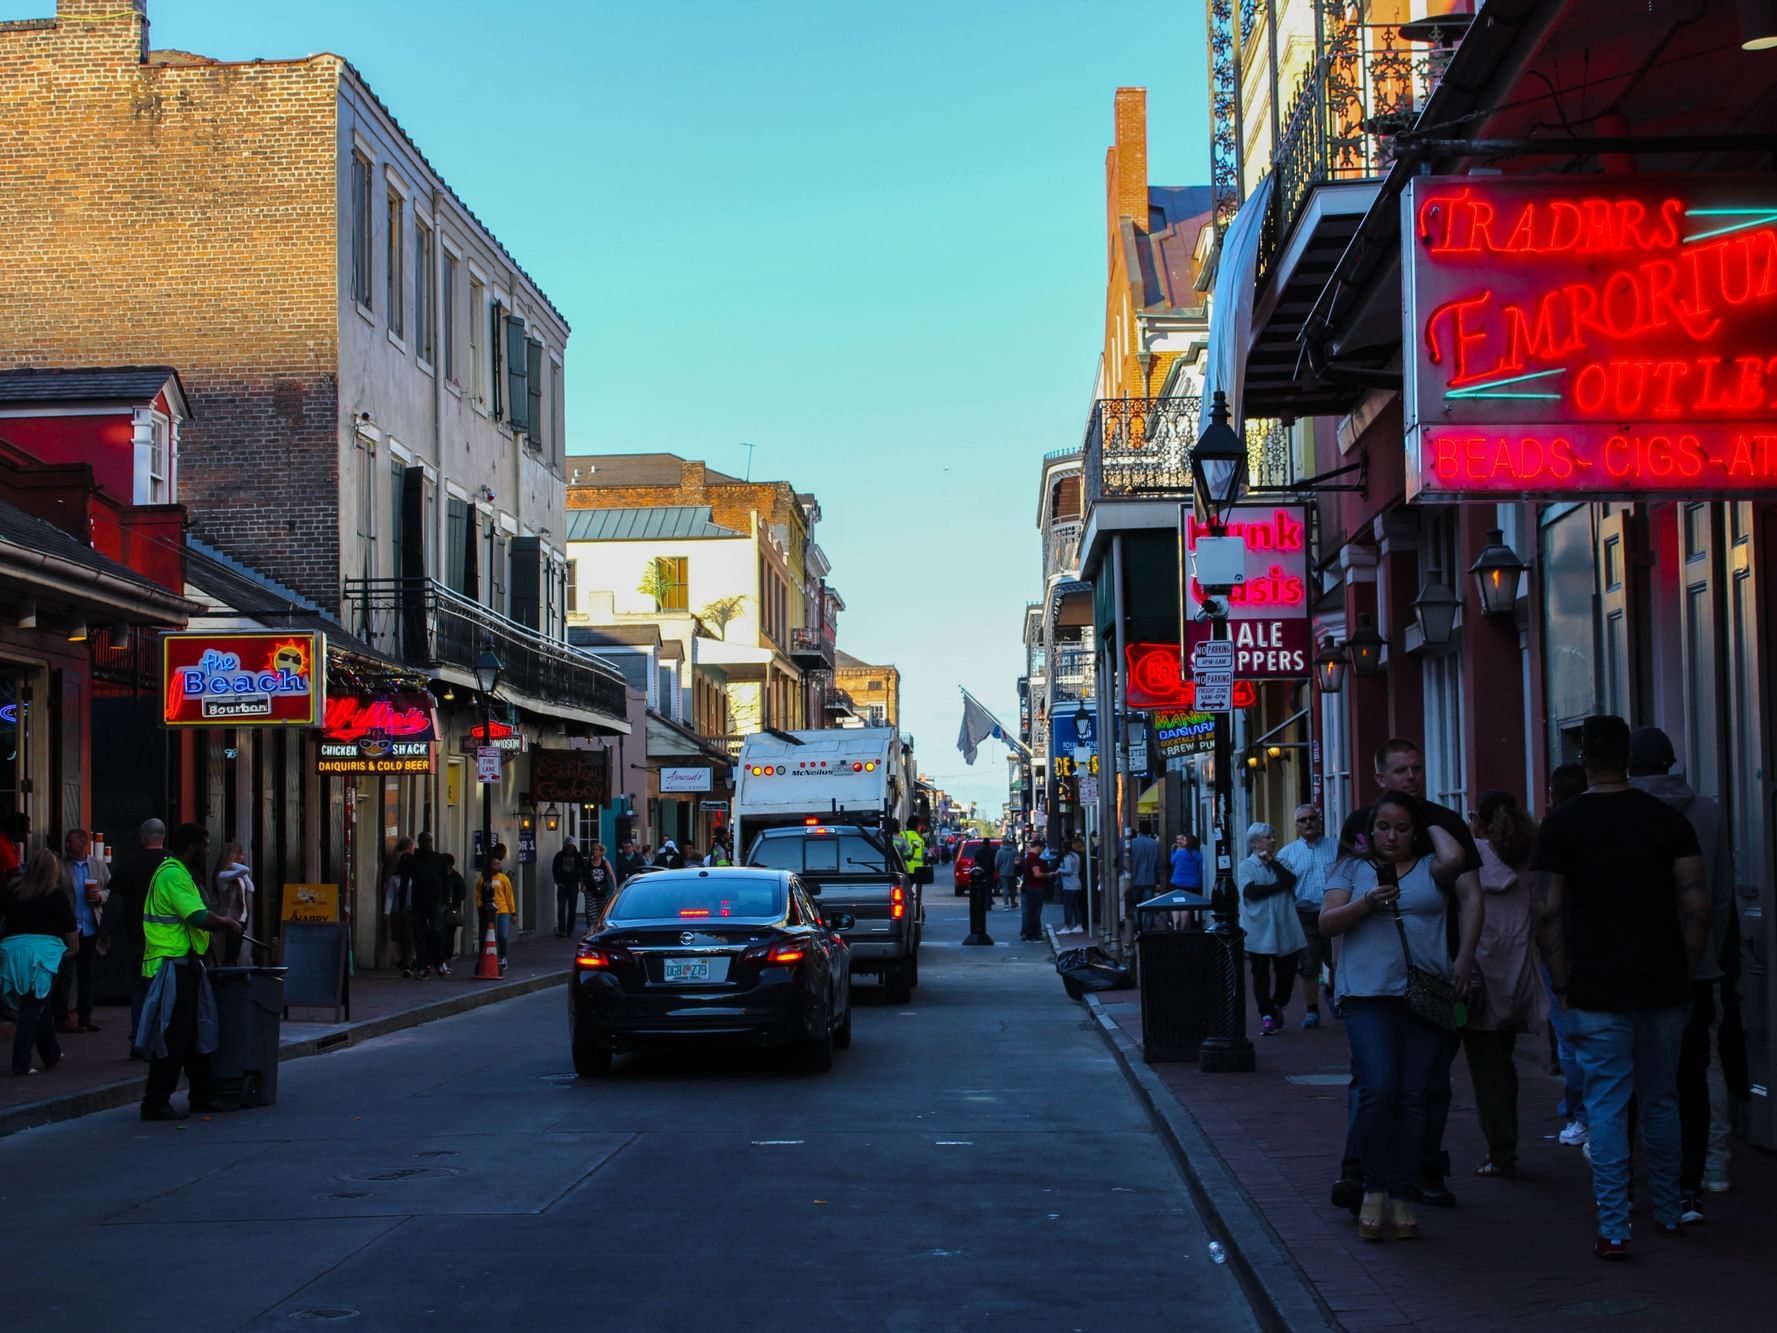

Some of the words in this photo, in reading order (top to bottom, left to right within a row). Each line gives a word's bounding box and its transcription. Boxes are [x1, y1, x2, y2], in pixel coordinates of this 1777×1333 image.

[1196, 645, 1207, 656] NO
[1208, 644, 1231, 654] PARKING
[203, 652, 236, 677] the
[183, 667, 306, 695] Beach
[1195, 675, 1206, 686] NO
[1207, 673, 1230, 683] PARKING
[209, 703, 268, 716] Bourbon
[321, 744, 358, 756] CHICKEN
[393, 743, 427, 755] SHACK
[318, 761, 366, 772] DAIQUIRIS
[368, 760, 375, 771] &
[377, 760, 402, 771] COLD
[404, 759, 429, 770] BEER
[792, 768, 834, 777] McNeilus
